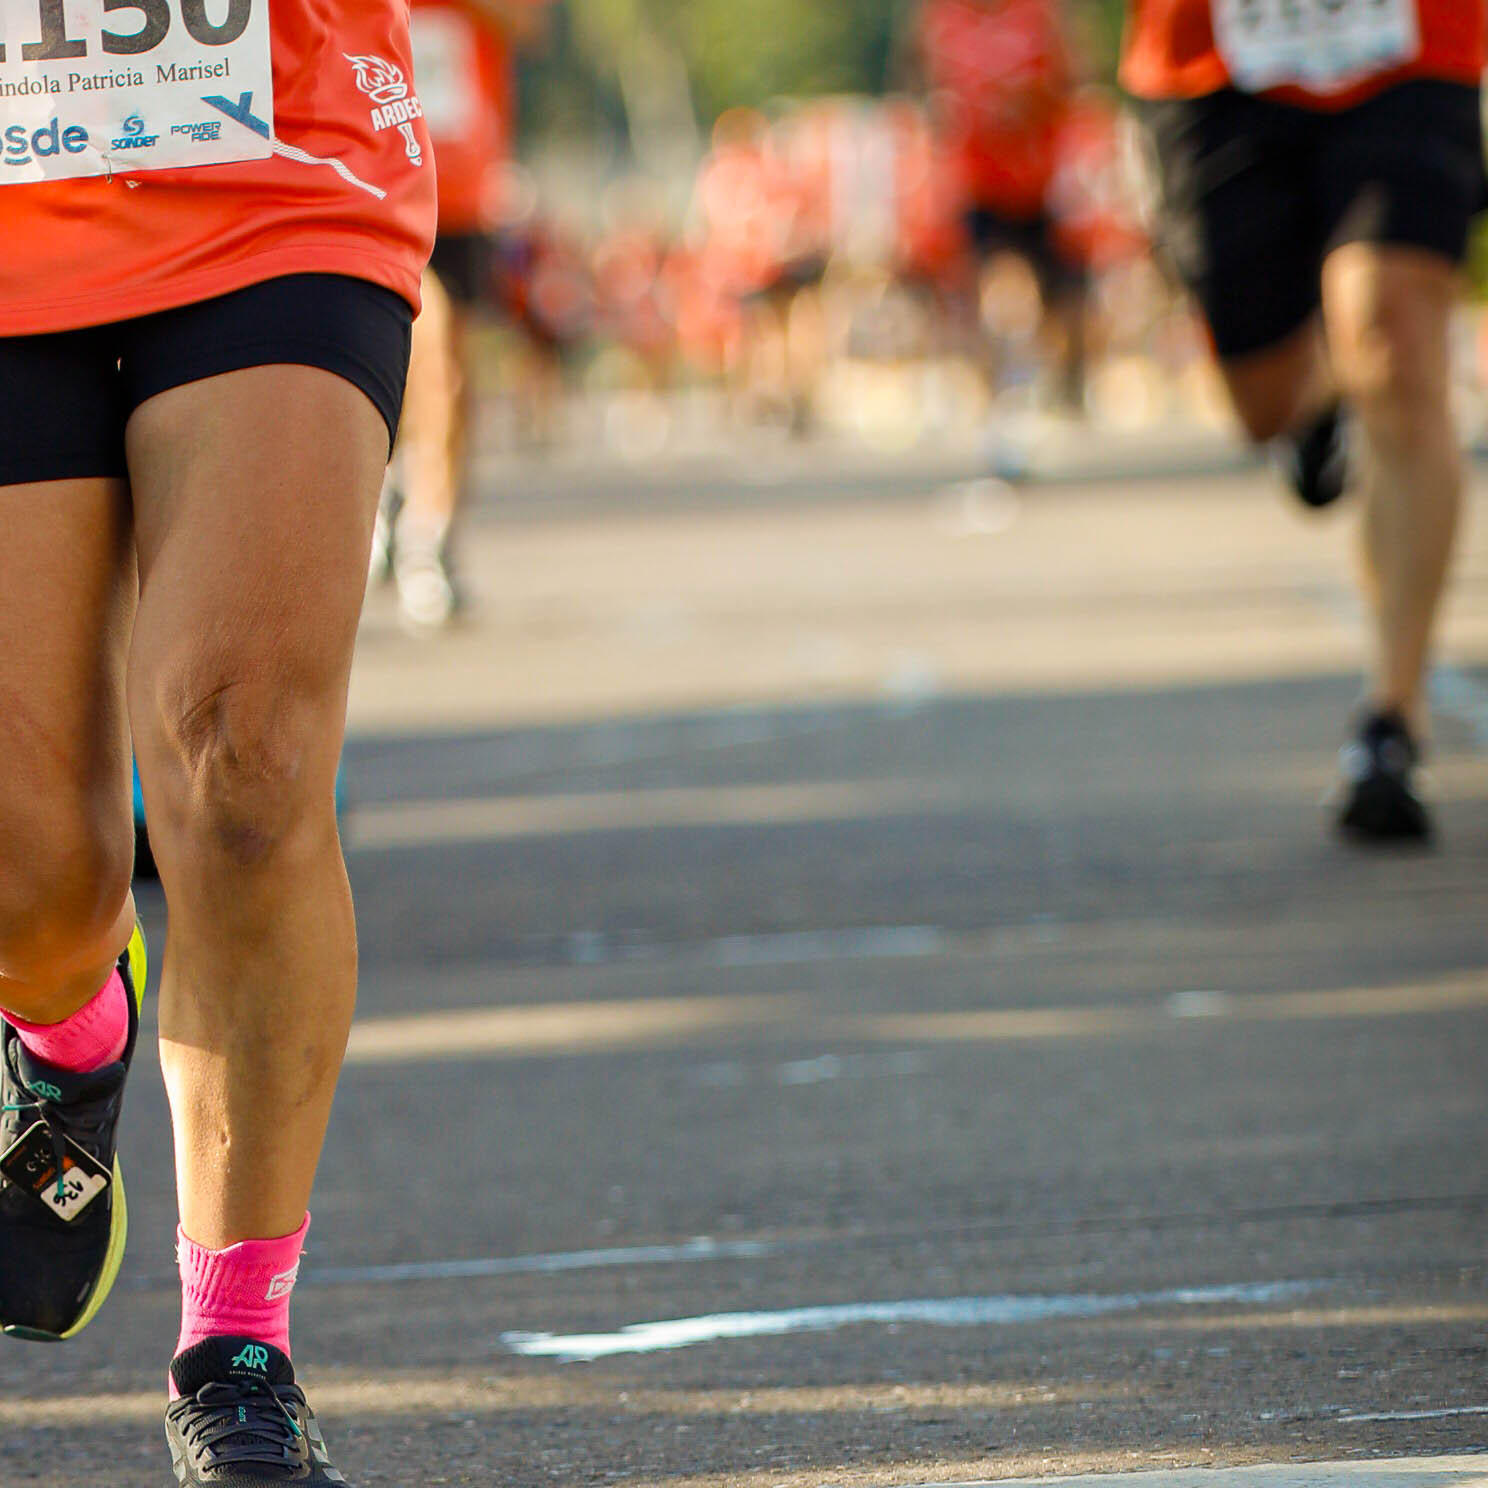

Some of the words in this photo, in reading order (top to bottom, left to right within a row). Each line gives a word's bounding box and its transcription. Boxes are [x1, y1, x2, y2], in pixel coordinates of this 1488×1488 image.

[67, 67, 145, 93] Patricia
[156, 58, 231, 84] Marisel
[170, 121, 222, 135] POWER
[370, 96, 422, 132] ARDEC
[231, 1344, 269, 1373] AR
